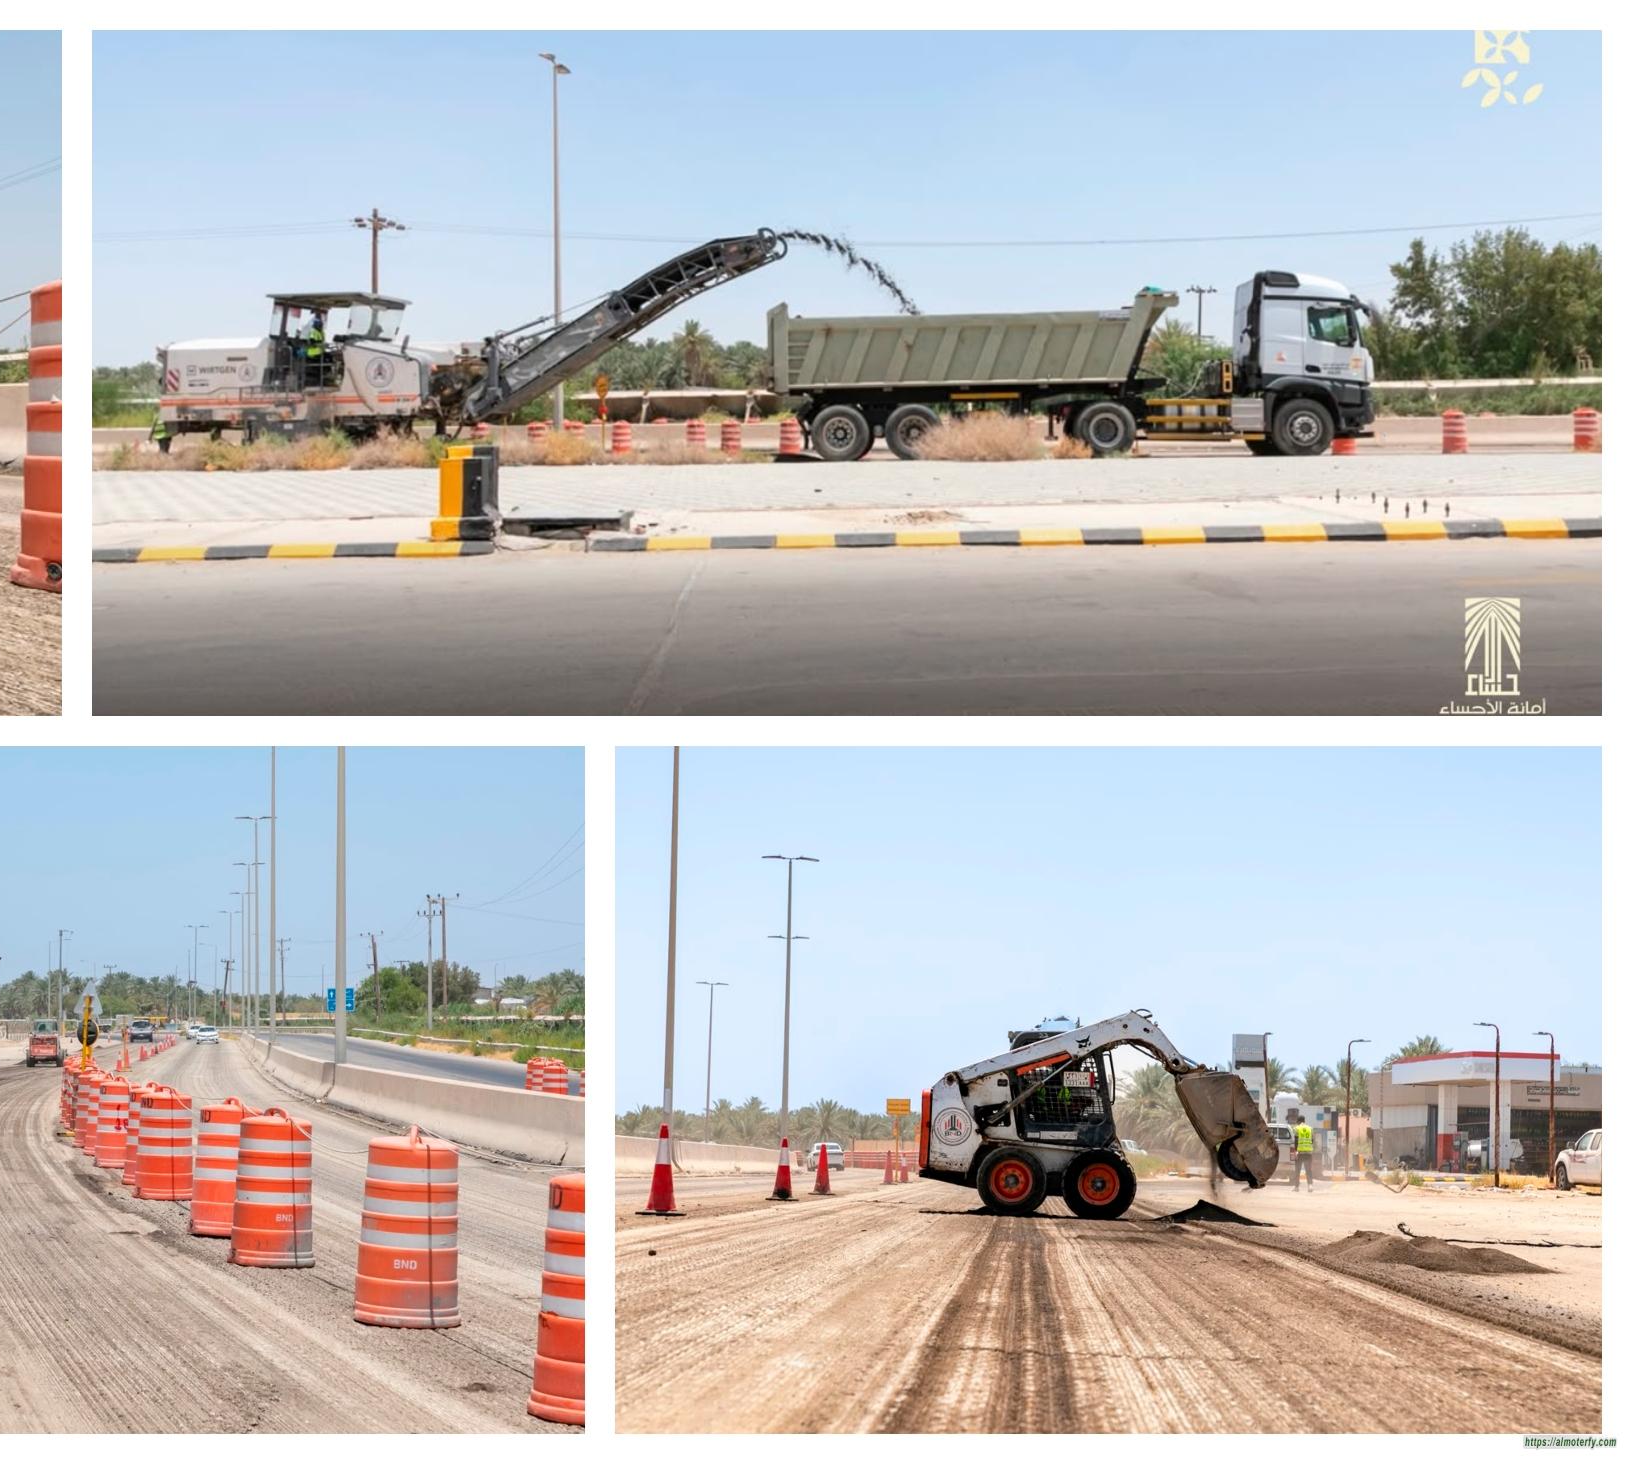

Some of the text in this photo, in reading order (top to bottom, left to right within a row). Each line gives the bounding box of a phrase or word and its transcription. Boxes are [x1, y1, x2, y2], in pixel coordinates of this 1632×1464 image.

[198, 365, 236, 374] WIRTGEN
[275, 1213, 293, 1222] BND
[393, 1258, 417, 1270] BND
